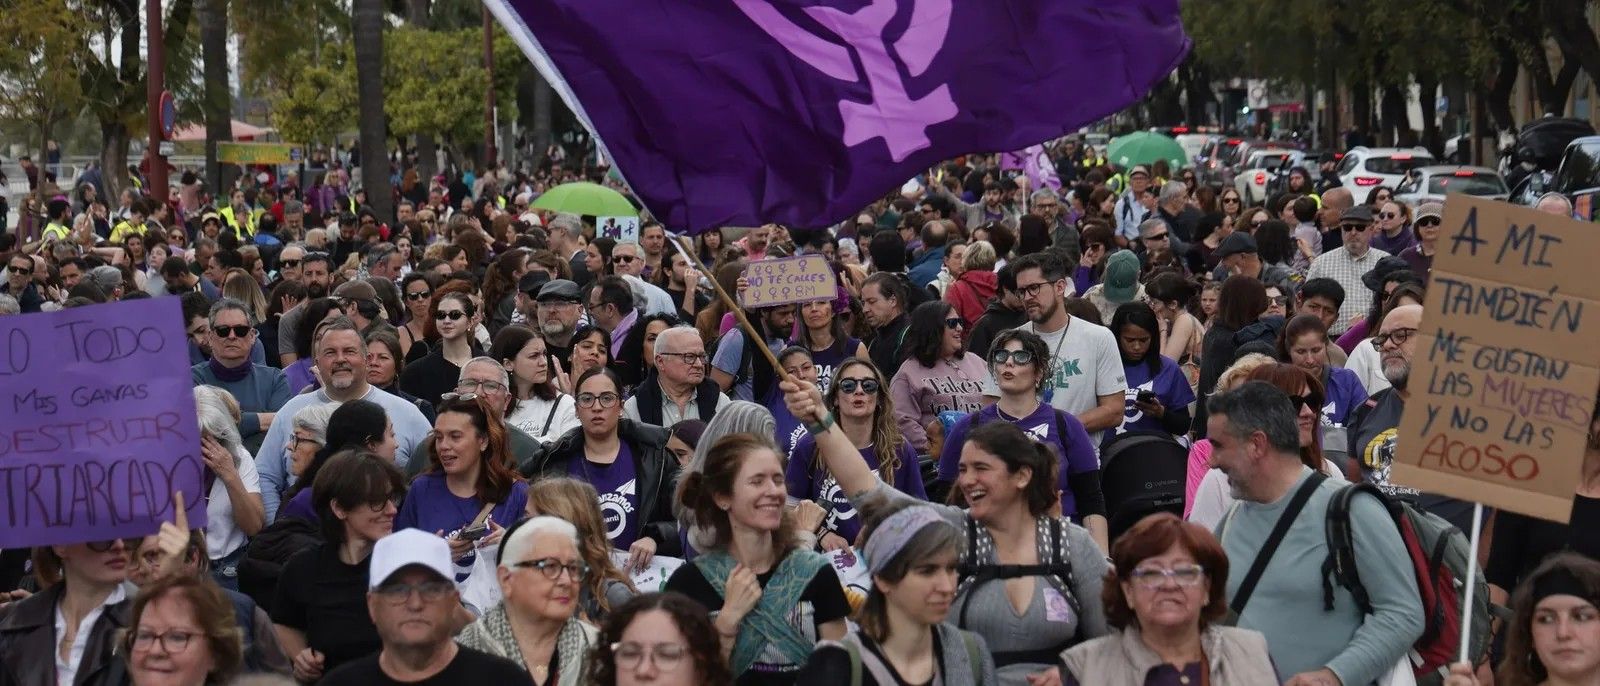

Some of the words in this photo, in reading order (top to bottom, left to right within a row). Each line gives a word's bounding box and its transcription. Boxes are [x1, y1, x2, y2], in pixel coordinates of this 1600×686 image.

[1452, 207, 1488, 256] A
[1495, 223, 1562, 267] MI
[748, 276, 763, 288] NO
[768, 274, 783, 284] TE
[787, 273, 826, 284] CALLES
[795, 285, 815, 298] 8M
[1434, 278, 1583, 334] TAMBIÉN
[0, 328, 30, 376] O
[54, 319, 165, 364] TODO
[1428, 328, 1472, 364] ME
[1472, 344, 1569, 382] GUSTAN
[13, 388, 58, 415] MIS
[71, 383, 149, 408] GANAS
[1428, 365, 1473, 397] LAS
[1481, 374, 1592, 428] MUJERES
[1421, 403, 1440, 438] Y
[1503, 413, 1554, 449] LAS
[1417, 432, 1540, 481] ACOSO
